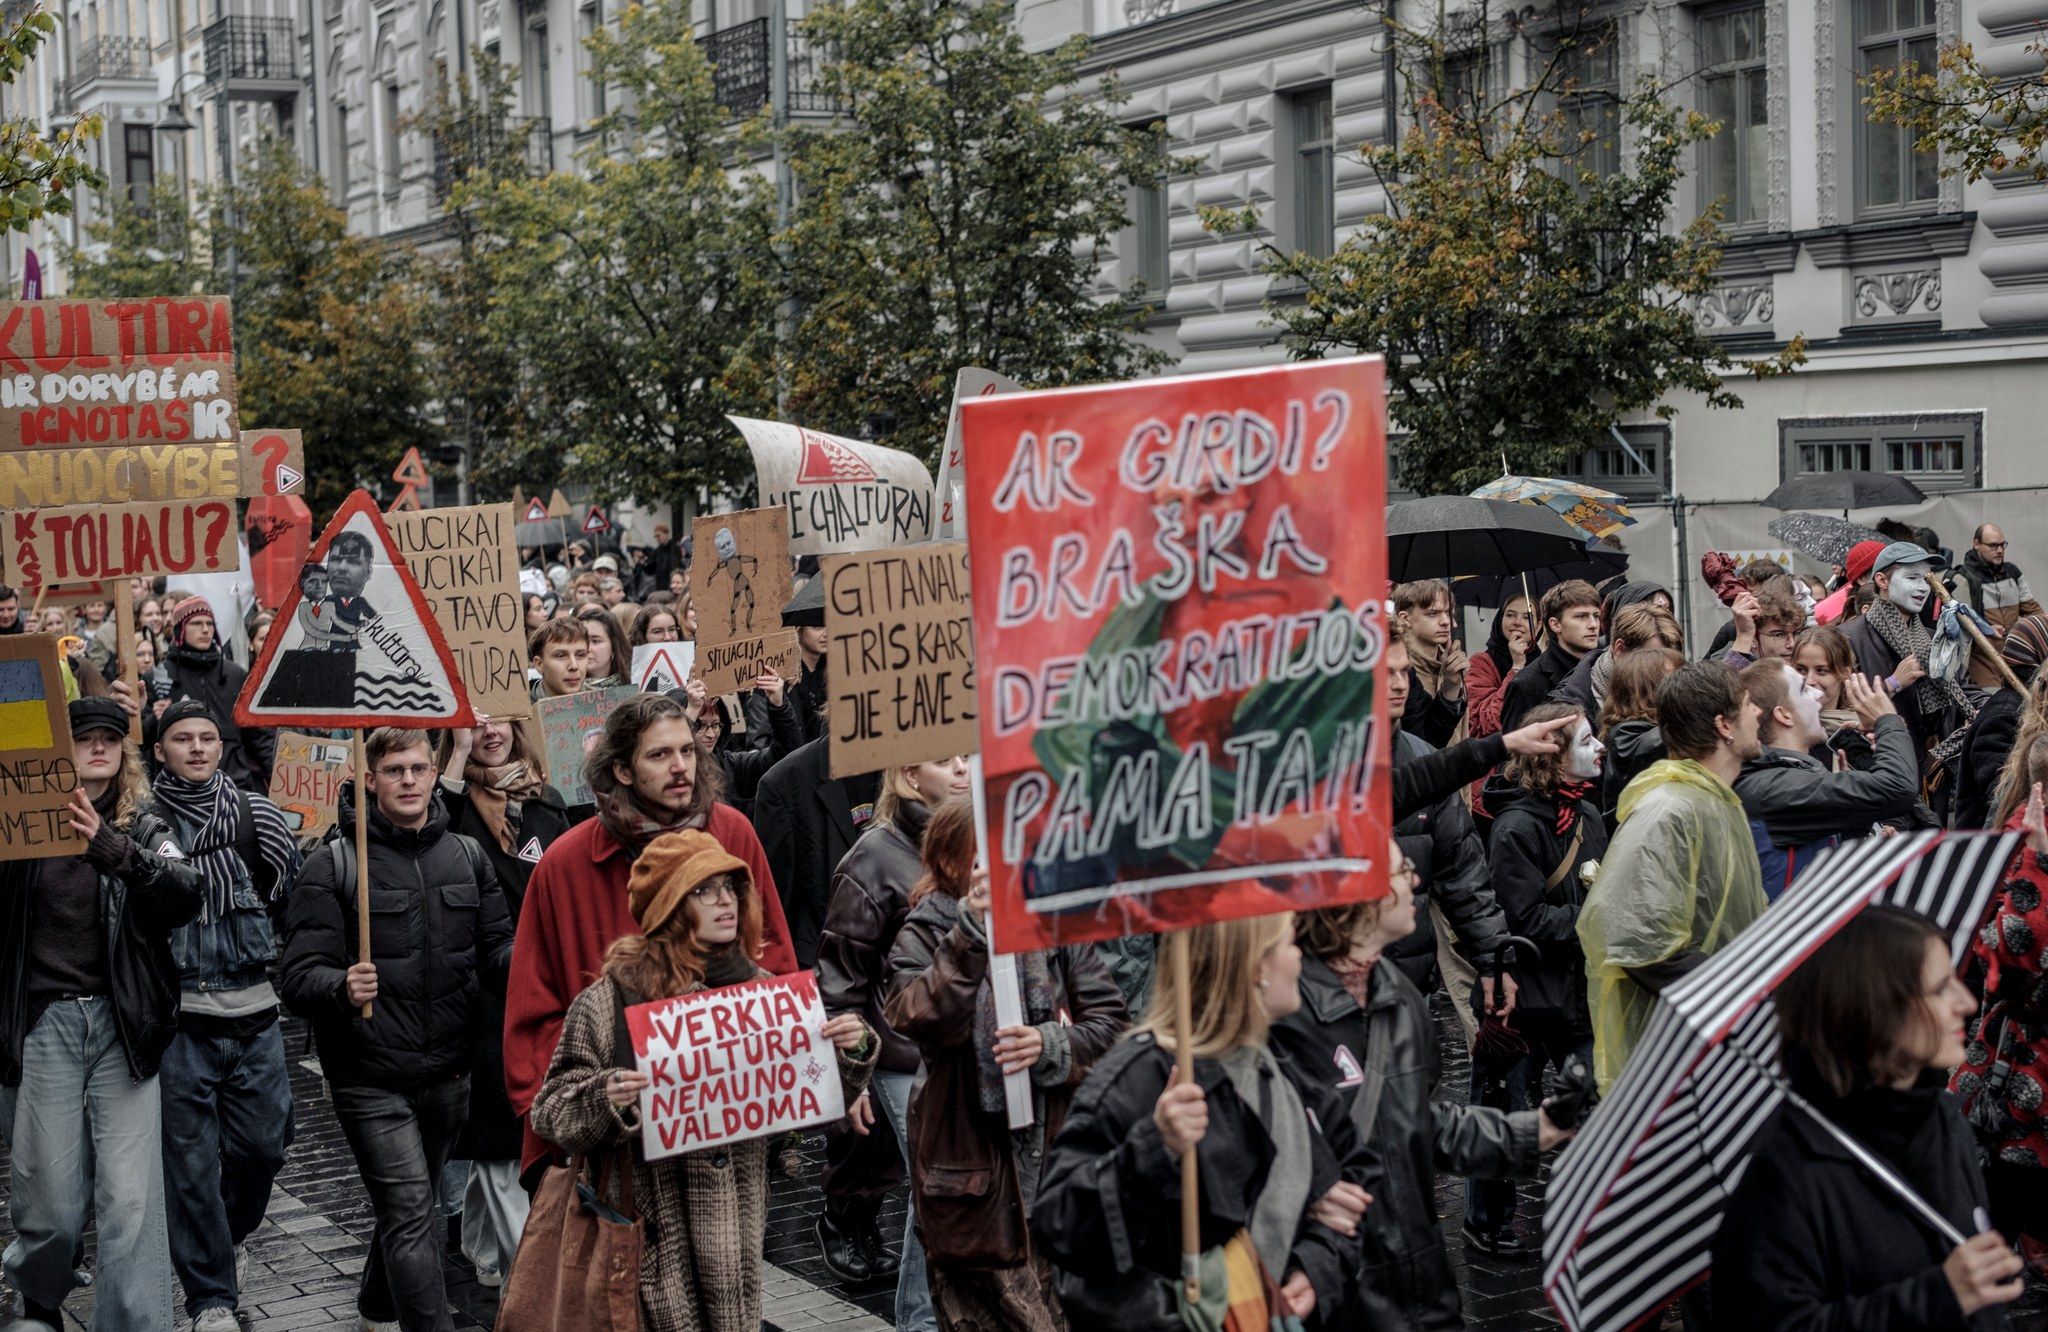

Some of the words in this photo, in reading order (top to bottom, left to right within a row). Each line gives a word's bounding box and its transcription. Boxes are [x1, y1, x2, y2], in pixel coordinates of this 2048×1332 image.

[1, 374, 39, 408] IR
[41, 367, 178, 404] DORYBĖ
[180, 369, 221, 398] AR
[20, 400, 191, 447] IGNOTAS
[193, 400, 231, 440] IR
[992, 431, 1095, 513] AR
[1119, 388, 1350, 494] GIRDI?
[44, 502, 231, 579] TOLIAU?
[386, 512, 501, 553] IUCIKAI
[995, 503, 1328, 628] BRAŠKA
[445, 592, 518, 633] TAVO
[833, 623, 911, 677] TRIS
[993, 600, 1383, 736] DEMOKRATIJOS
[840, 690, 883, 743] JIE
[272, 763, 356, 807] SUREIK
[656, 992, 803, 1051] VERKIA
[651, 1025, 812, 1088] KULTŪRA
[652, 1062, 797, 1122] NEMUNO
[658, 1086, 822, 1151] VALDOMA
